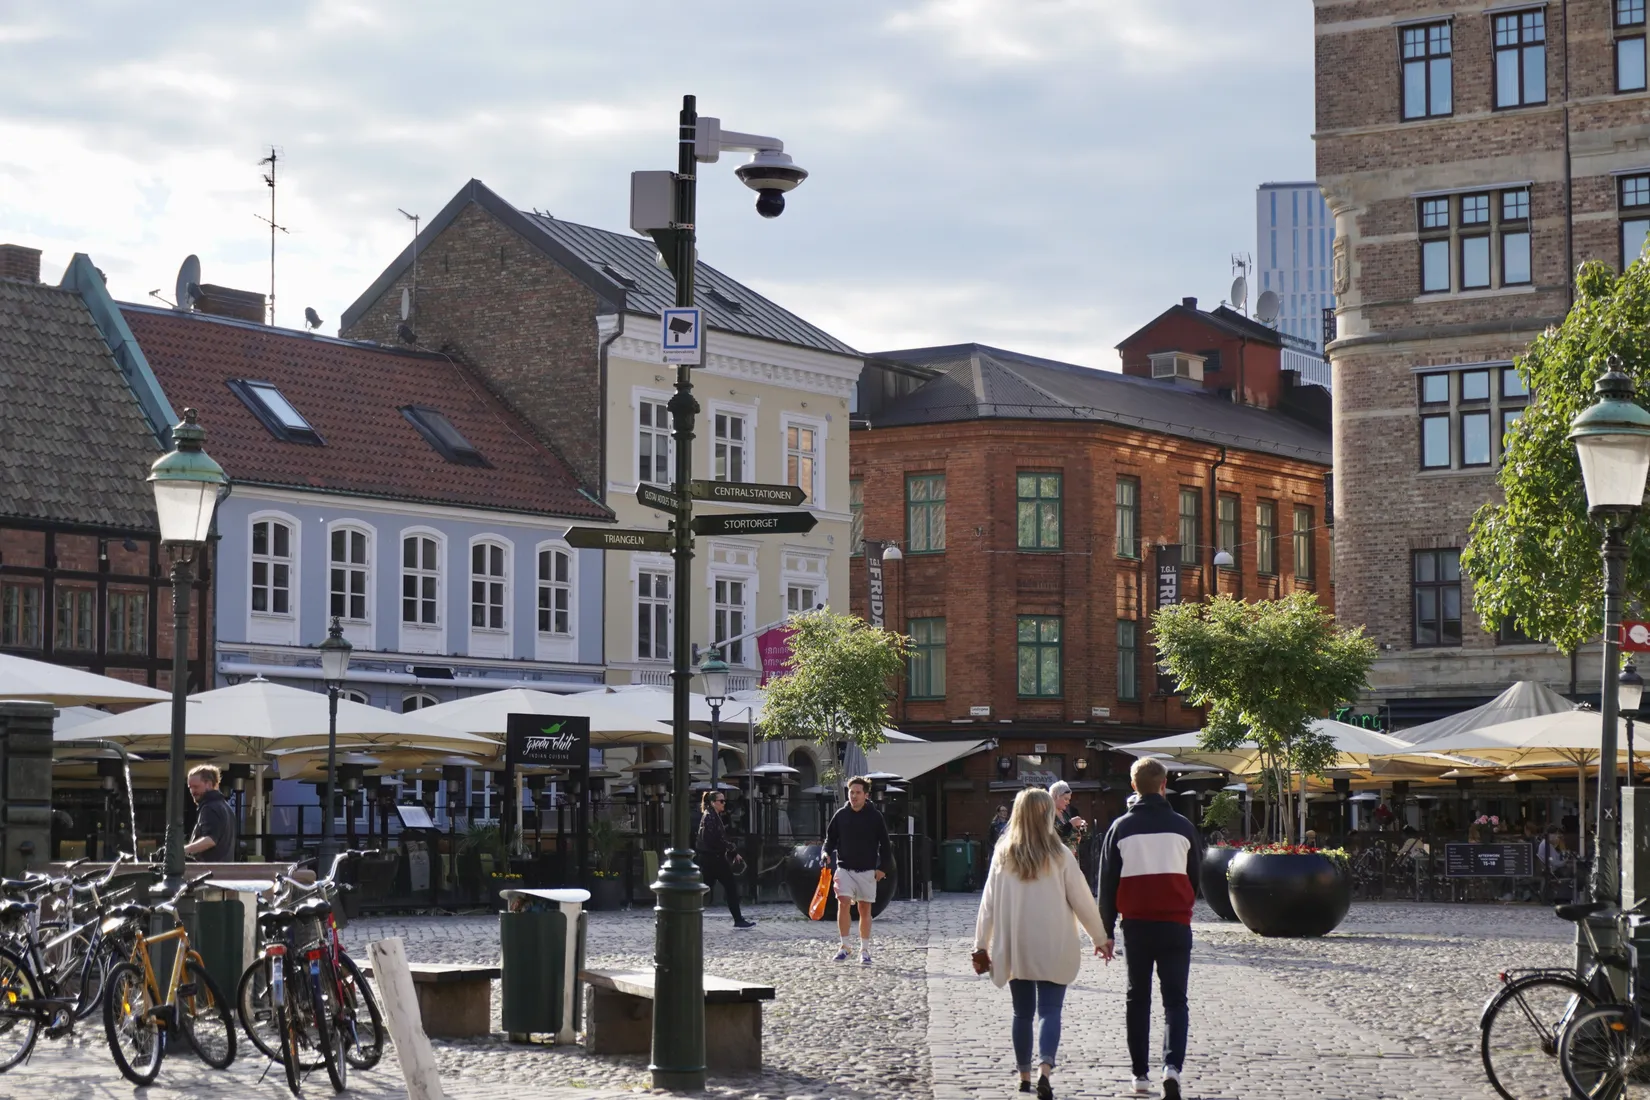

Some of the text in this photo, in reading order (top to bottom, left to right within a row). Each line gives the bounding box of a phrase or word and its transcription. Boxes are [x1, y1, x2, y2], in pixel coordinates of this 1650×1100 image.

[714, 486, 792, 500] CENTRALSTATIONEN
[724, 518, 779, 529] STORTORGET
[604, 534, 645, 545] TRIANGELN
